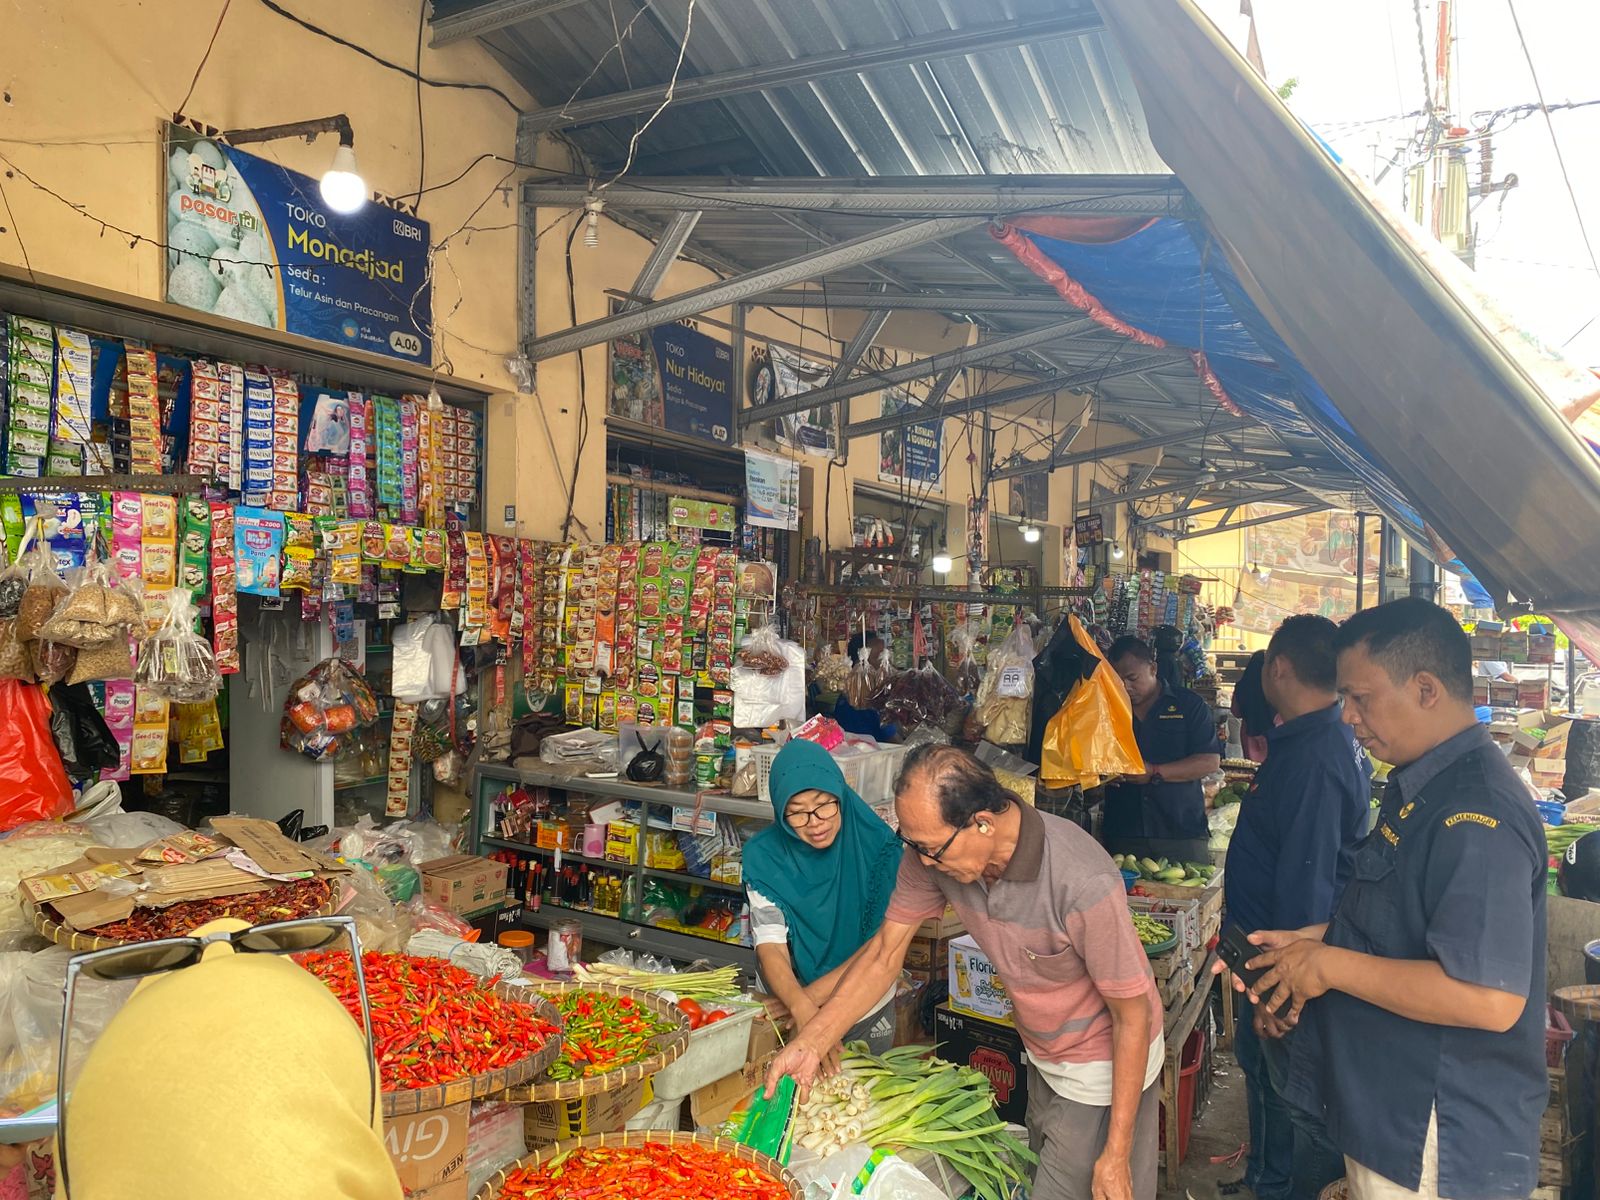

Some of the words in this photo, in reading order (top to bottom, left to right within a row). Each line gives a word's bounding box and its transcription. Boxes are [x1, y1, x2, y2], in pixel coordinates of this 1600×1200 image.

[286, 203, 326, 228] TOKO
[404, 220, 421, 241] BRI
[288, 224, 404, 284] Monadjad
[290, 284, 312, 300] Telur
[314, 291, 334, 305] Asin
[335, 296, 353, 310] dan
[354, 302, 400, 322] Pracangan
[394, 336, 418, 352] A.06
[665, 341, 685, 358] TOKO
[666, 358, 686, 378] Nur
[688, 366, 726, 394] Hidayat
[144, 500, 158, 508] Good
[1446, 813, 1496, 828] KEMENDAGRI
[442, 1154, 464, 1181] NEW
